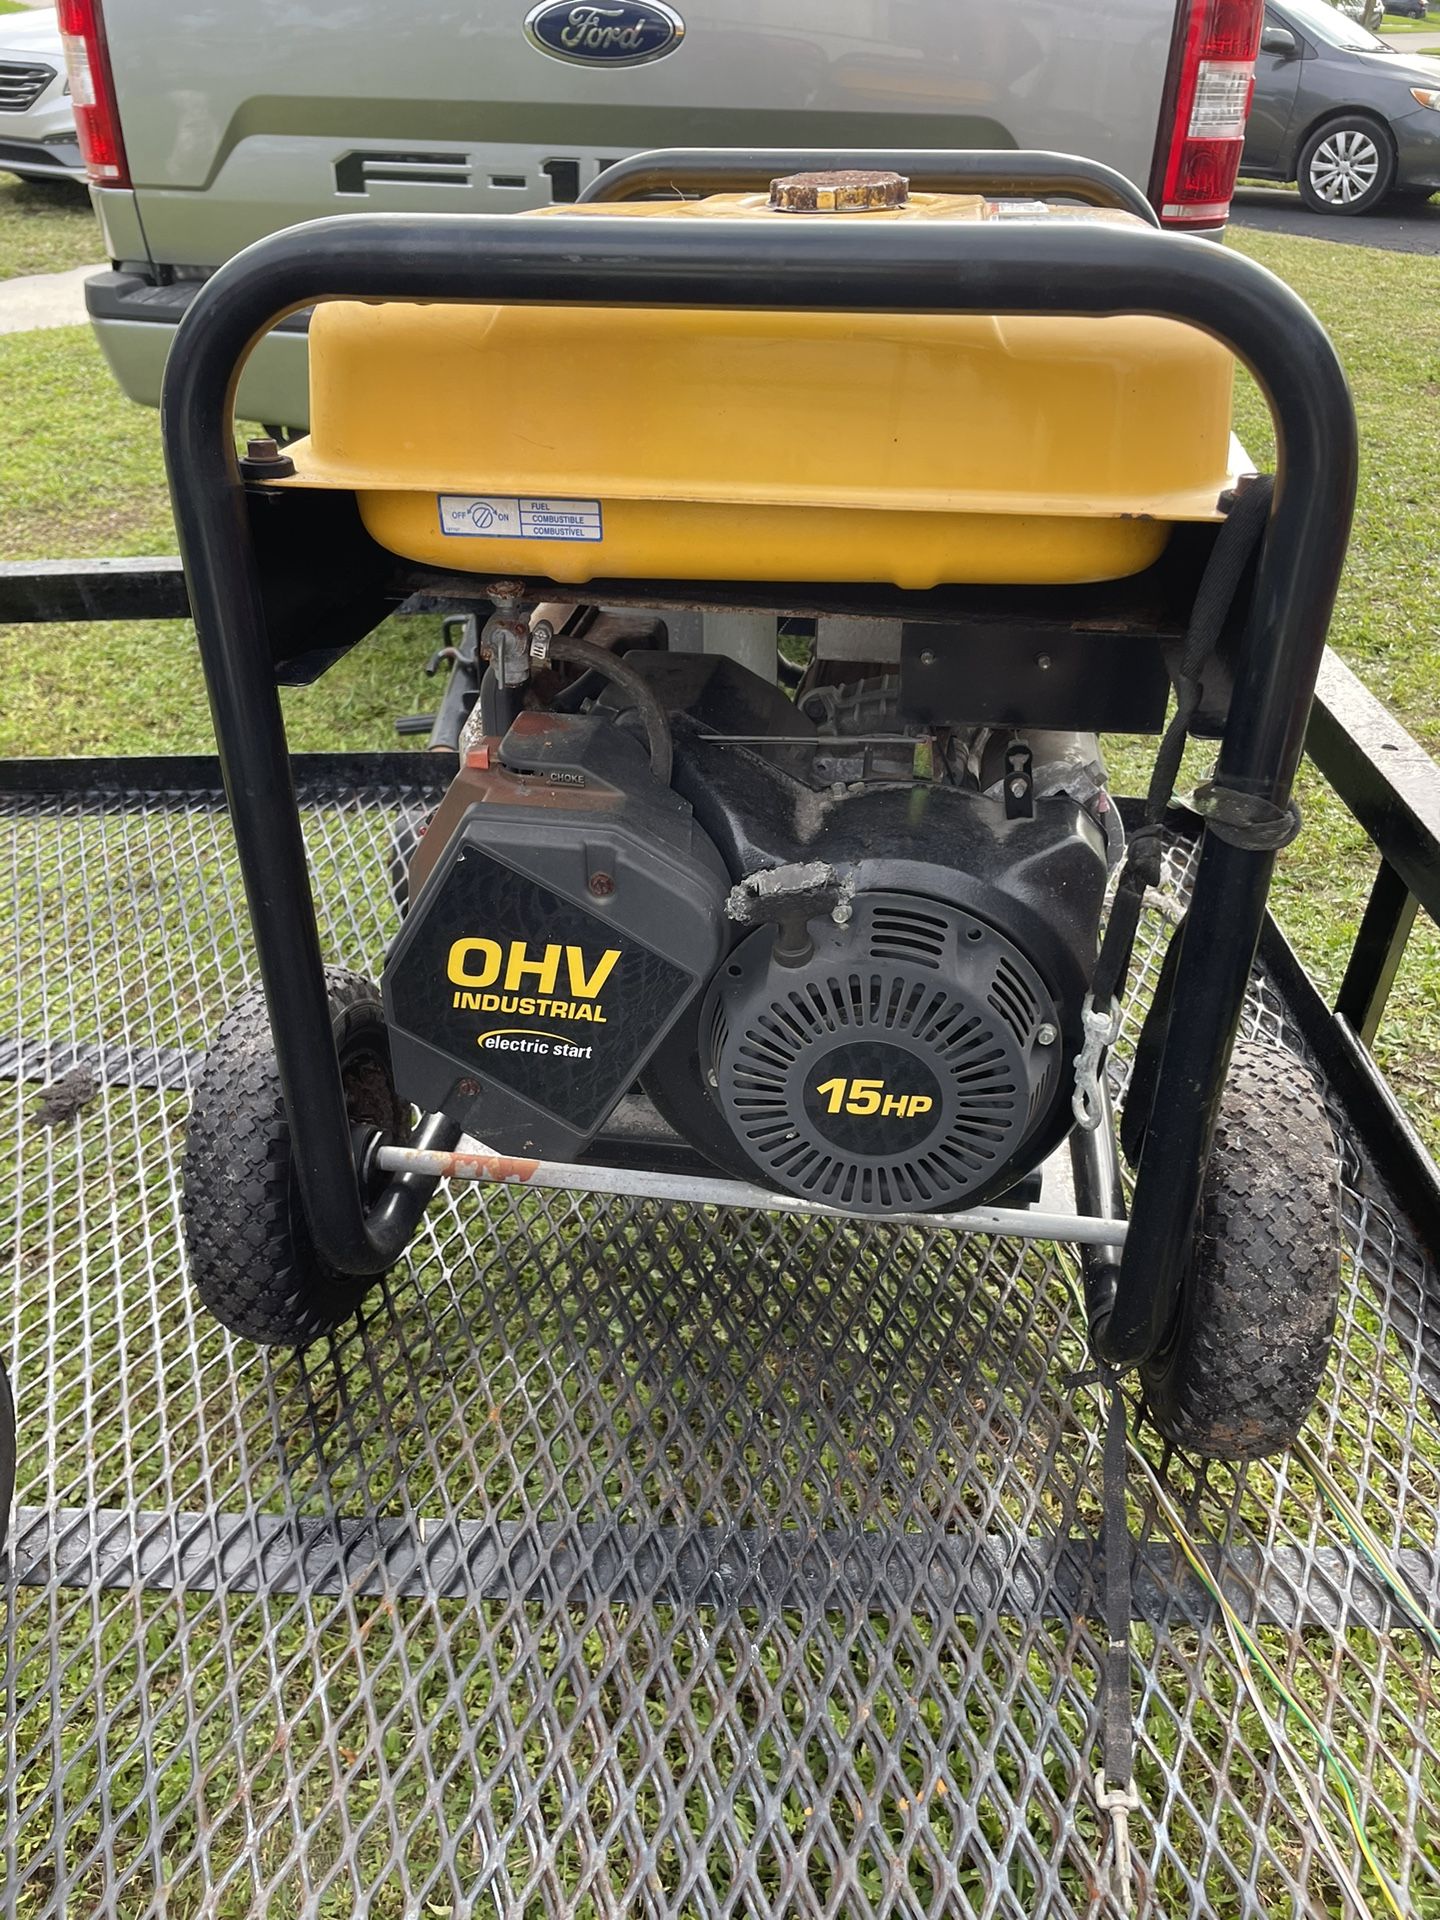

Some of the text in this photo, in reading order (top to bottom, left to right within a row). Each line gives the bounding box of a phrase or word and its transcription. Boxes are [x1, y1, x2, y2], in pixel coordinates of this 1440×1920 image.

[561, 6, 645, 49] Ford
[531, 502, 550, 511] FUEL
[452, 511, 509, 521] OFF ON
[532, 514, 584, 524] COMBUSTIBLE
[533, 526, 585, 536] COMBUSTÍVEL
[550, 772, 585, 784] CHOKE
[447, 937, 622, 998] OHV
[452, 991, 607, 1022] INDUSTRIAL
[485, 1035, 593, 1059] electric start
